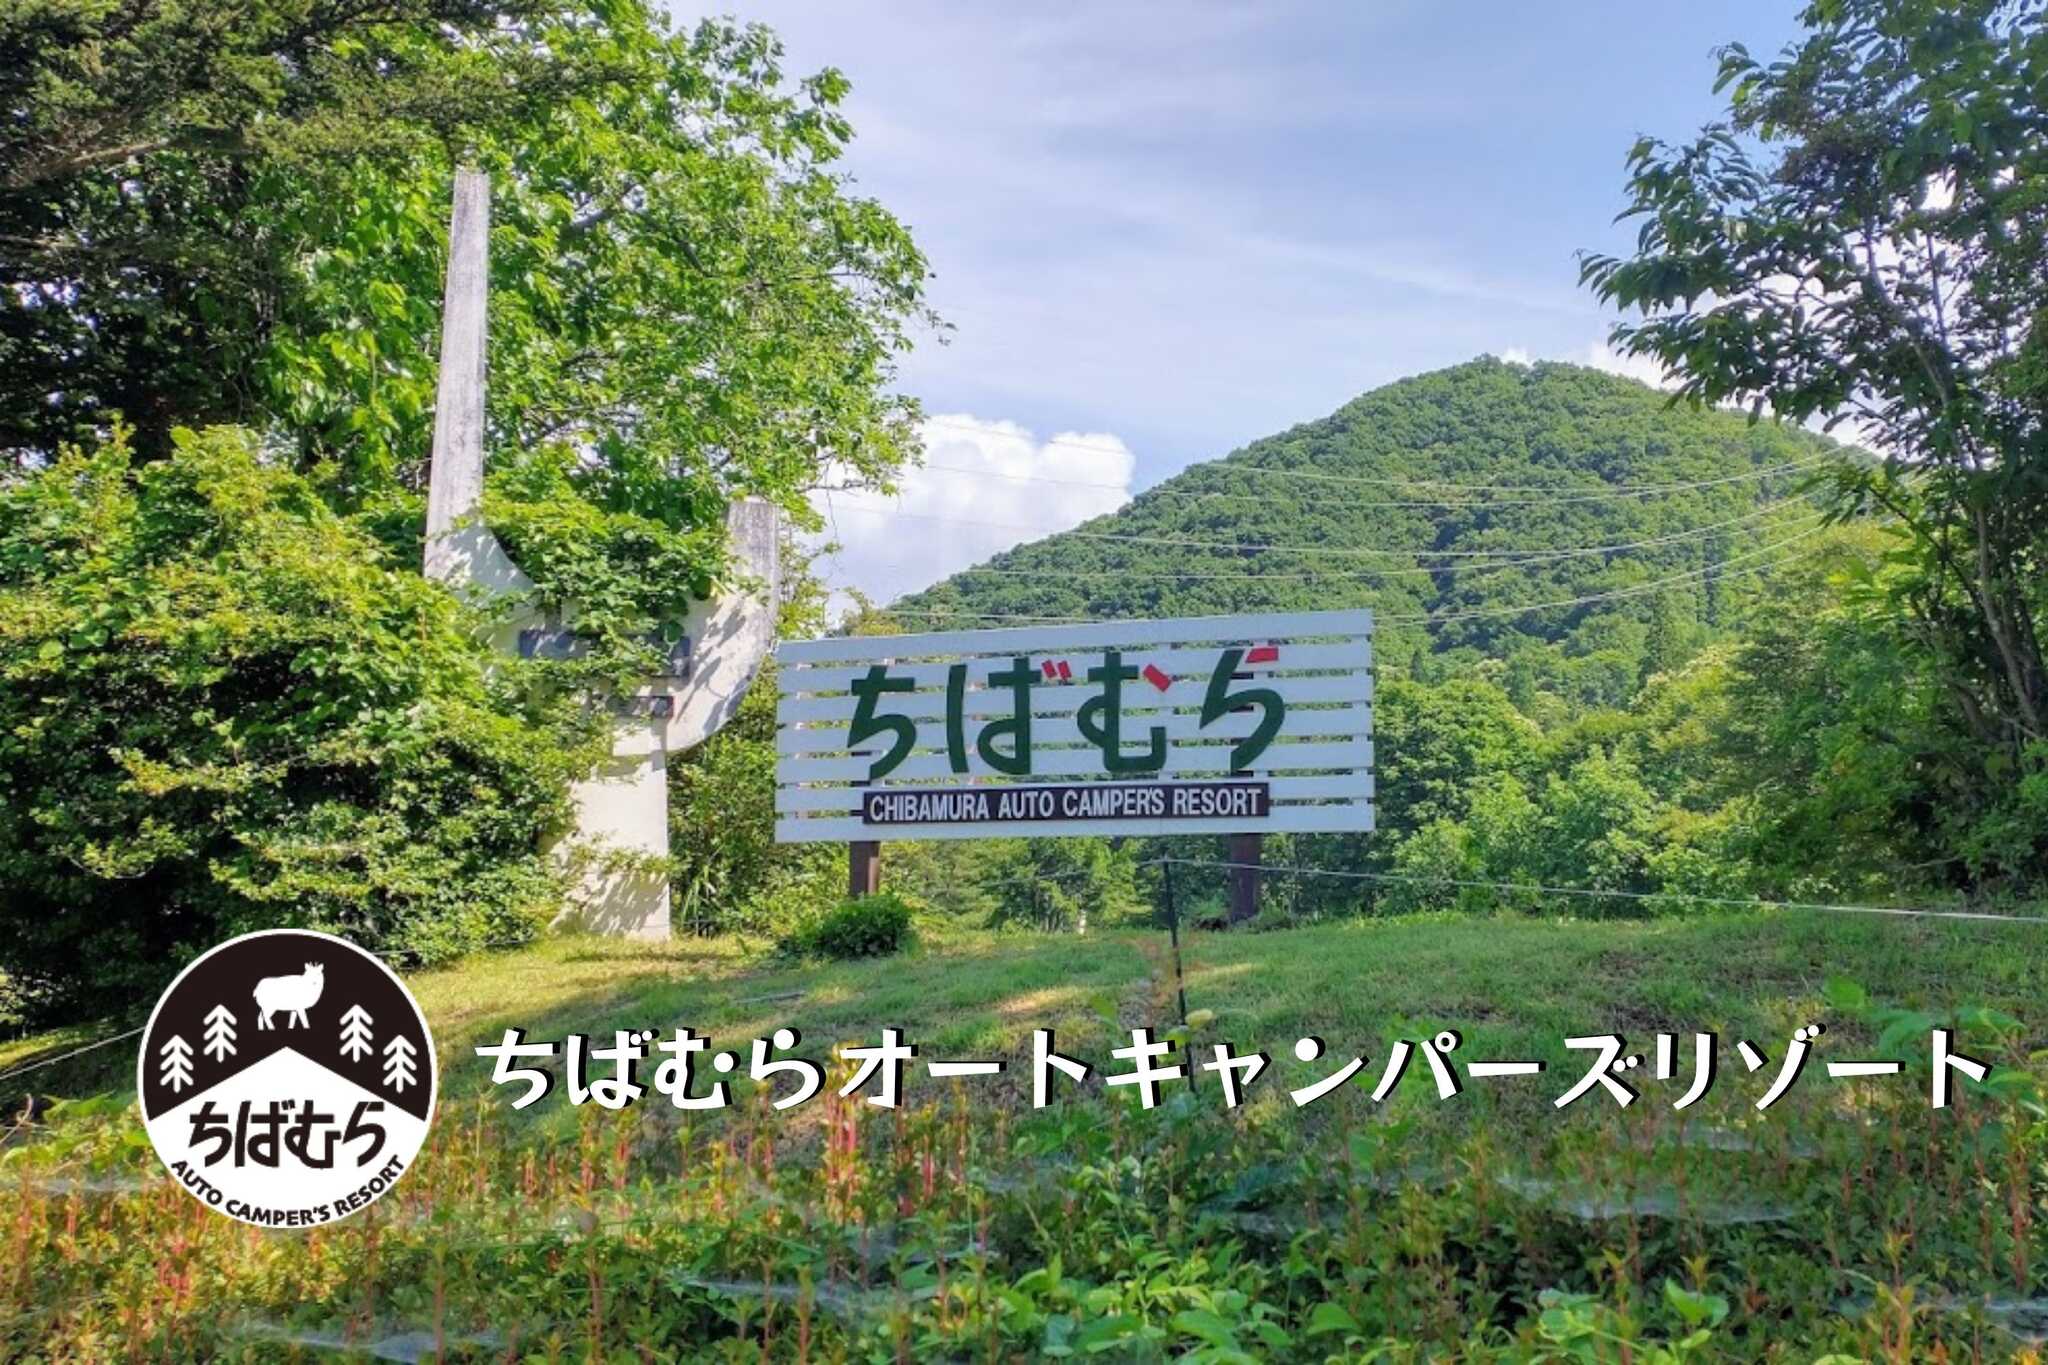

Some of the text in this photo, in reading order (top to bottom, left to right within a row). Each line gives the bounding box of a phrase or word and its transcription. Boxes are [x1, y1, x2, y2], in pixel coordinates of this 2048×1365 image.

[846, 646, 1286, 780] ちばむら
[869, 786, 1262, 822] CHIBAMURA AUTO CAMPER'S RESORT
